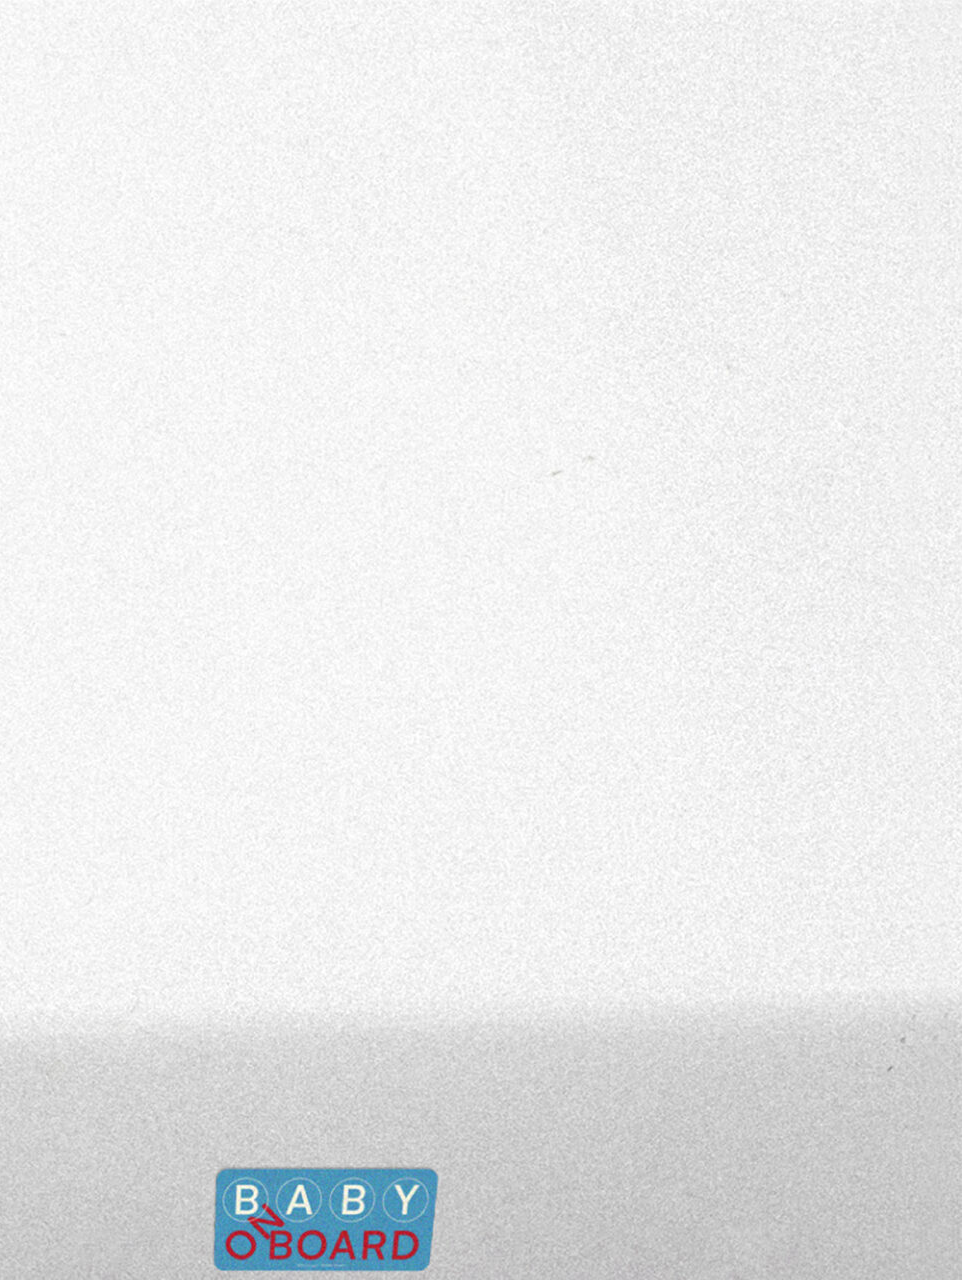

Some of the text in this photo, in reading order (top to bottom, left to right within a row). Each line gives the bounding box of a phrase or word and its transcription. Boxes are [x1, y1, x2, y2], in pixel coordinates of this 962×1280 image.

[234, 1184, 420, 1216] BABY
[225, 1203, 420, 1260] ON BOARD
